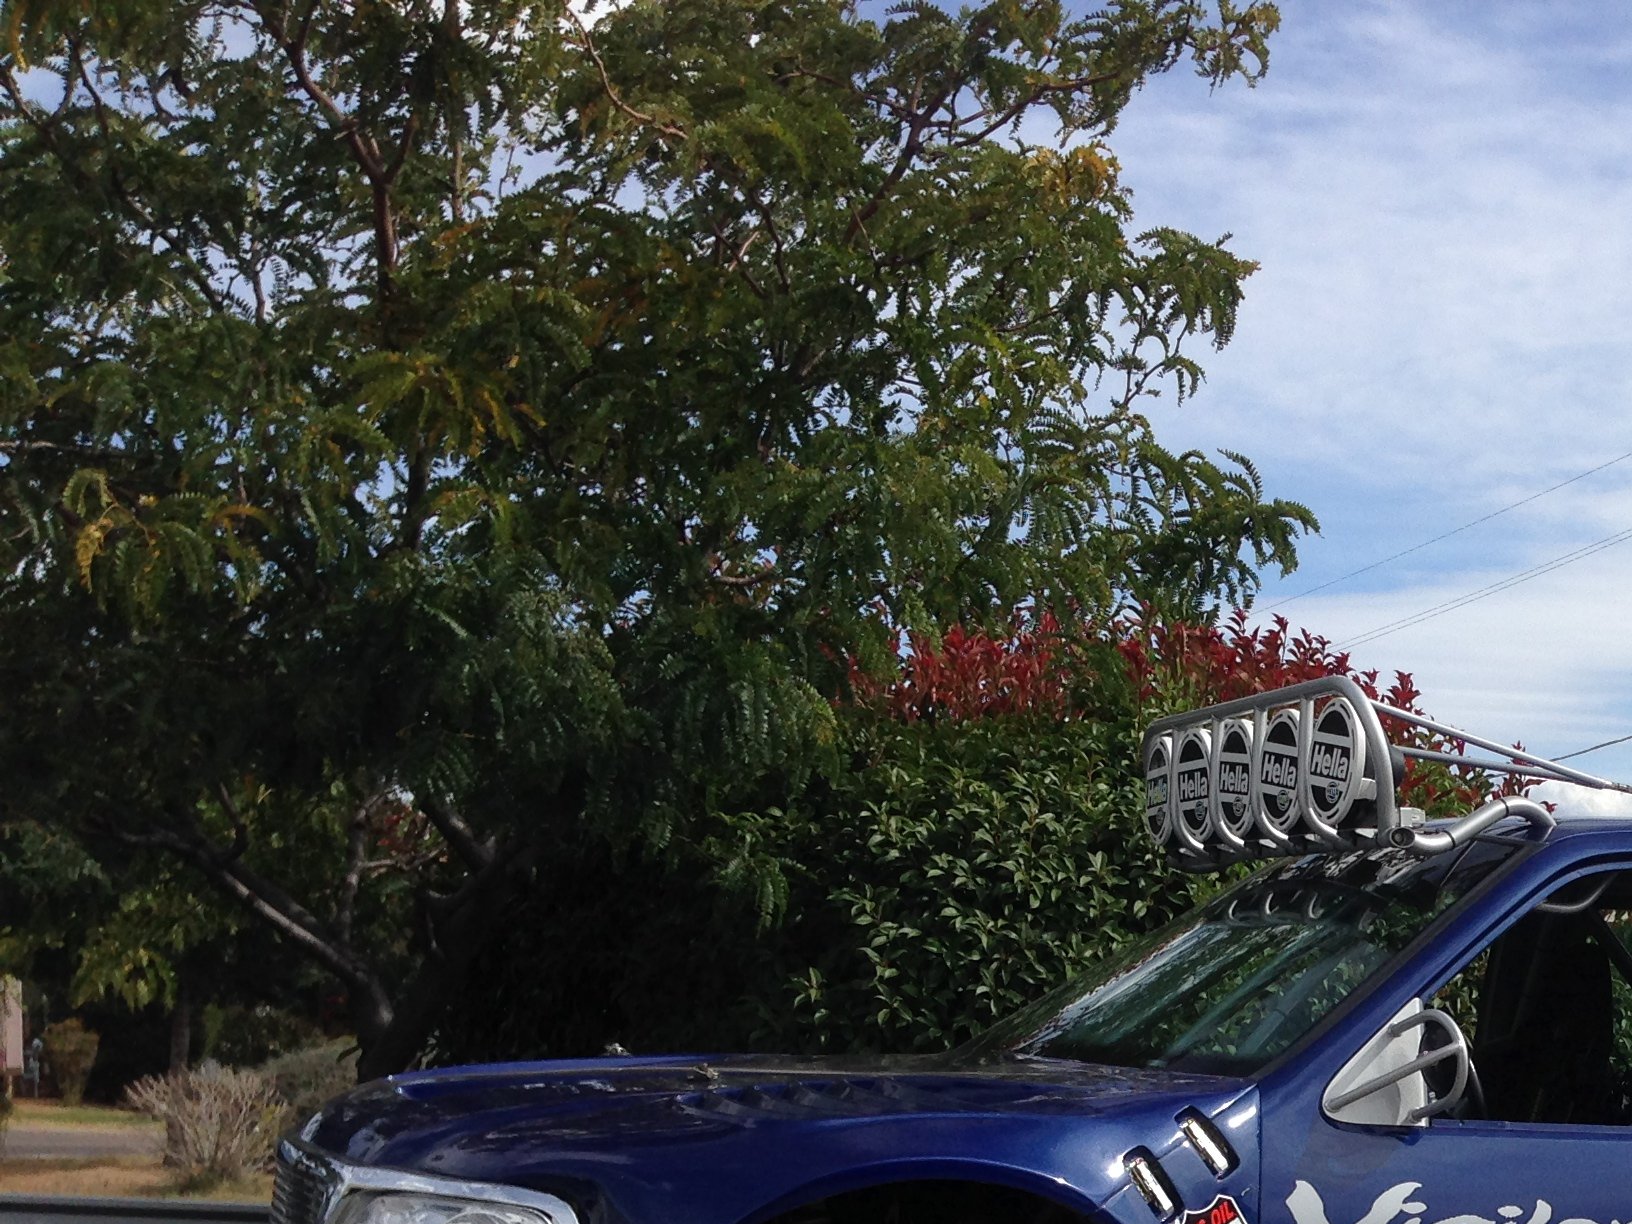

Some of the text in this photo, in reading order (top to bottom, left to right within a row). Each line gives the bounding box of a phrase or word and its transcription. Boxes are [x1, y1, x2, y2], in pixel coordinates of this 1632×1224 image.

[1220, 763, 1249, 793] Hella
[1262, 753, 1297, 788] Hella
[1311, 744, 1348, 780] Hella
[1180, 771, 1208, 800] Hella
